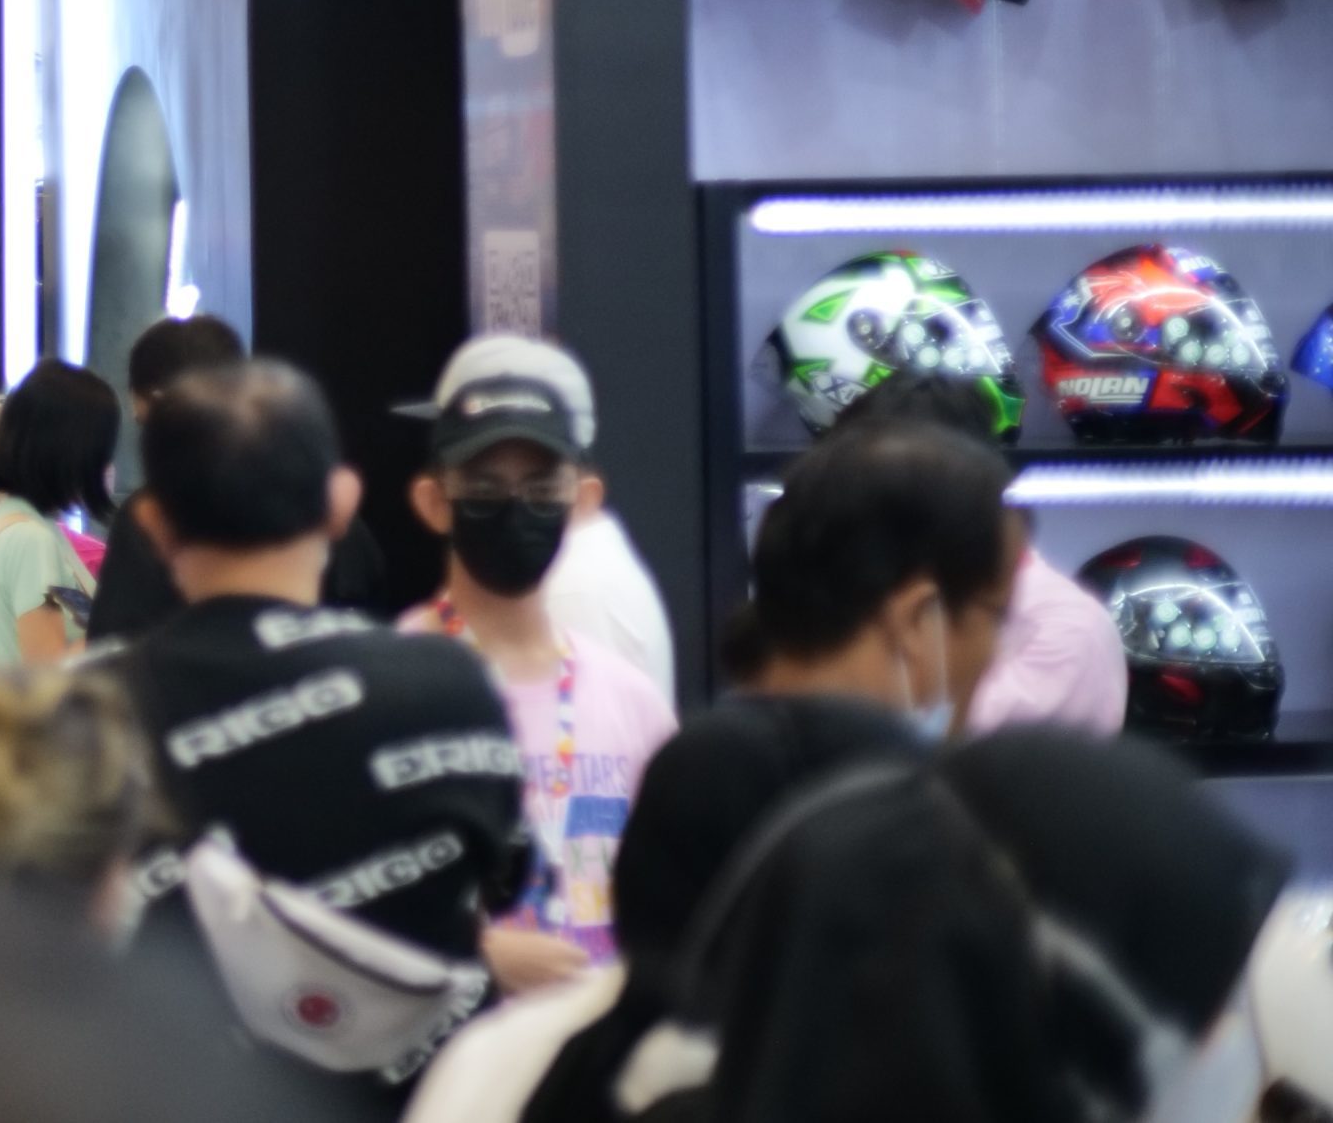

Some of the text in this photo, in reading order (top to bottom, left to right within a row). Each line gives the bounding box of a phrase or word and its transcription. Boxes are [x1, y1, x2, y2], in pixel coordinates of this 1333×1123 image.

[1058, 377, 1150, 400] NOLAN
[166, 673, 362, 768] RIGO
[317, 832, 464, 909] RIGO
